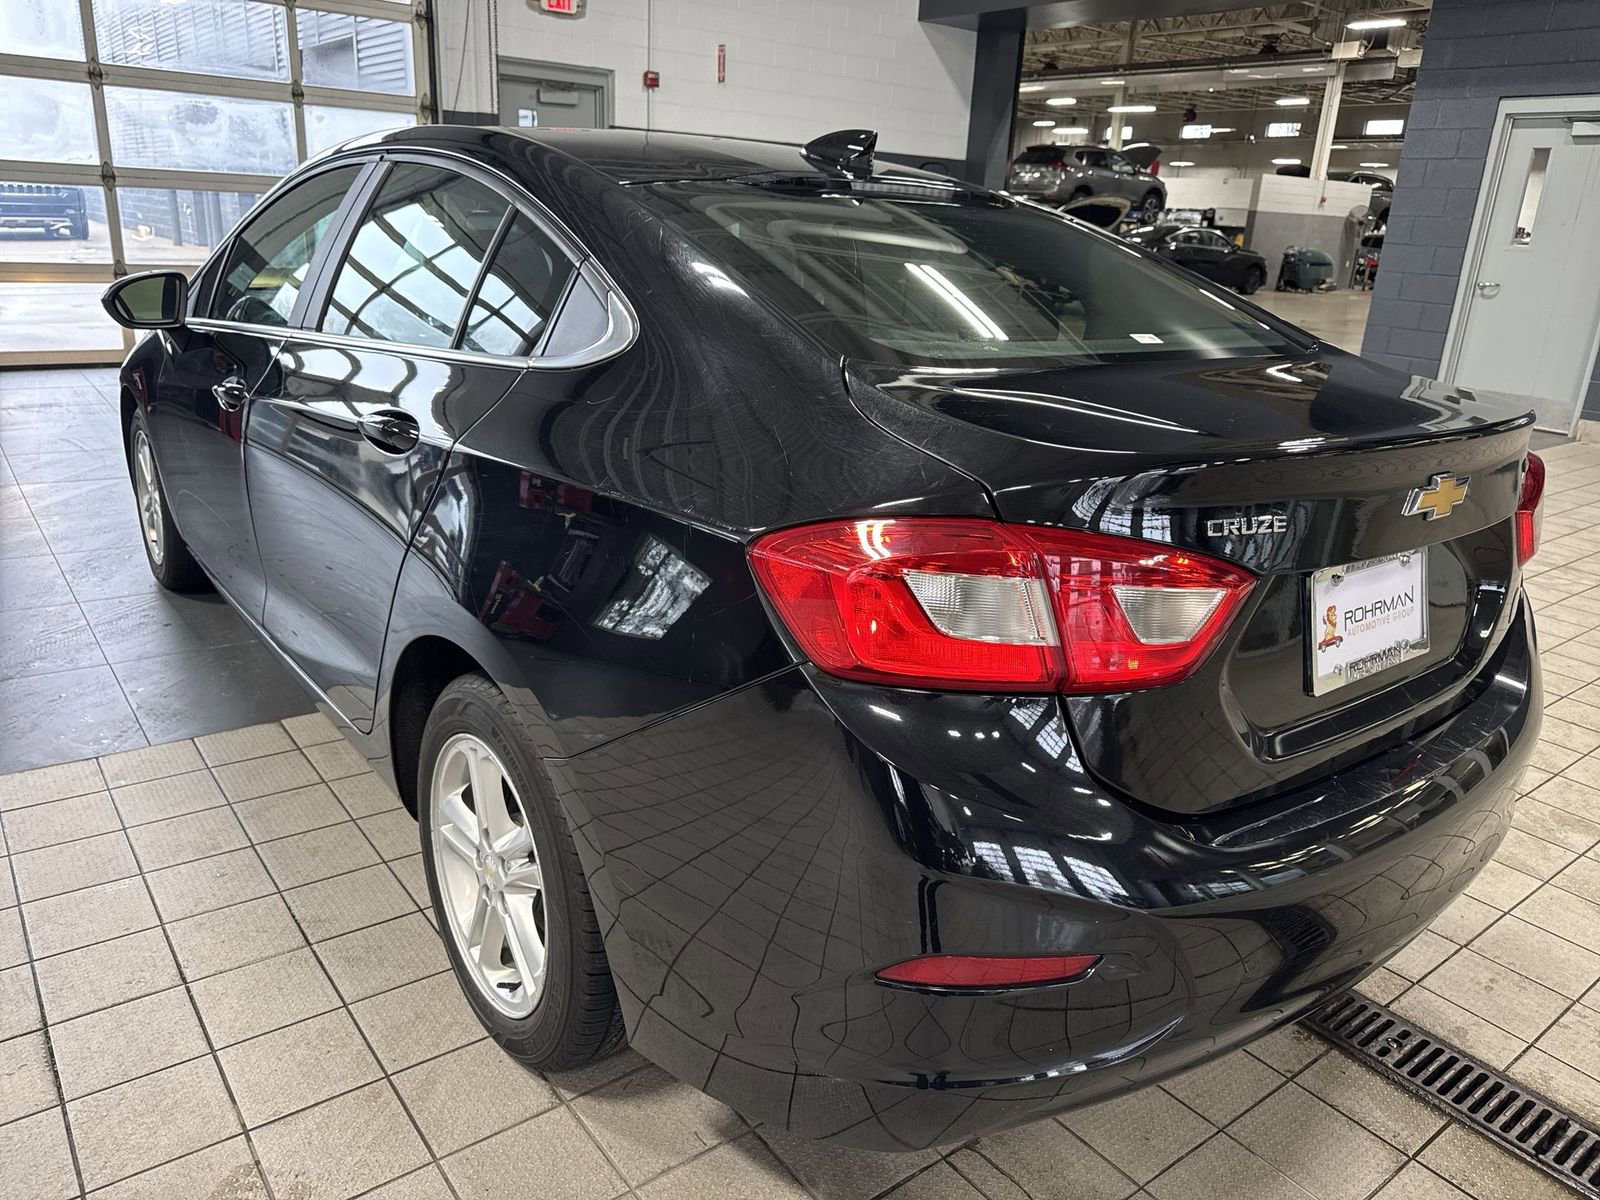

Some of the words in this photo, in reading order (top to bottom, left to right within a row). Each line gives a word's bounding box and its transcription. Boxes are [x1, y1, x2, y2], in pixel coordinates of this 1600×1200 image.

[1207, 515, 1287, 537] CRUZE
[1344, 585, 1414, 632] ROHRMAN
[1347, 614, 1391, 637] AUTOMOTIVE
[1392, 606, 1415, 622] GROUP
